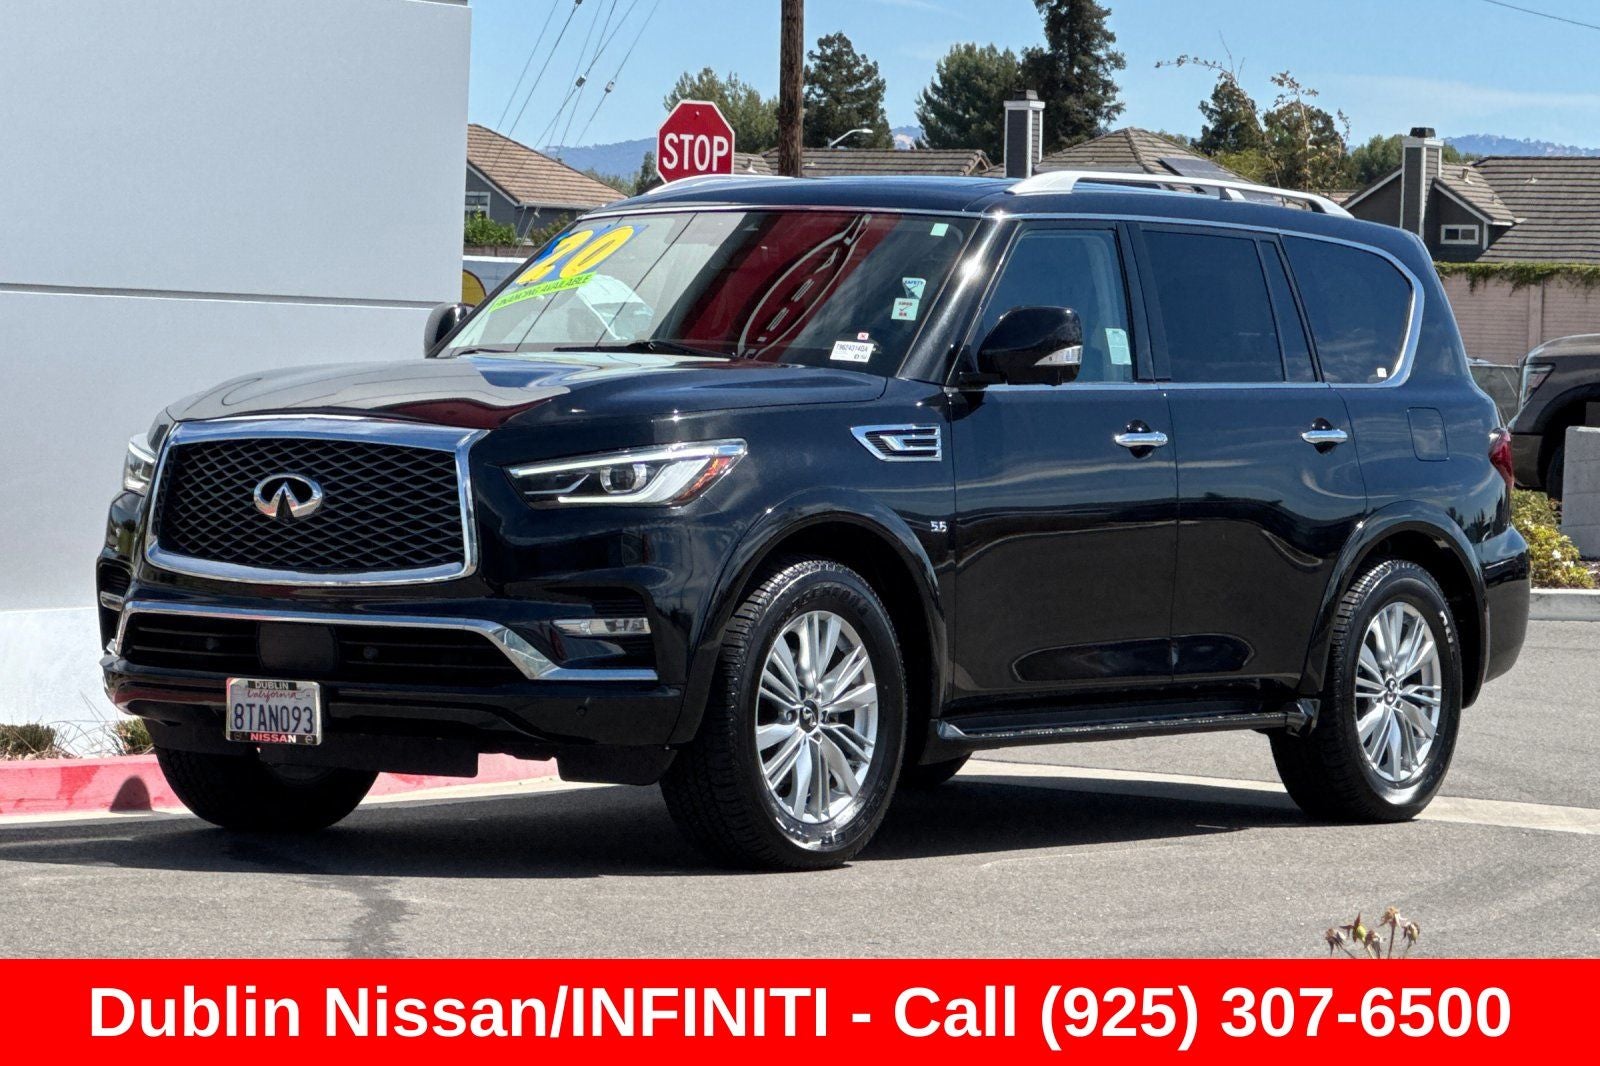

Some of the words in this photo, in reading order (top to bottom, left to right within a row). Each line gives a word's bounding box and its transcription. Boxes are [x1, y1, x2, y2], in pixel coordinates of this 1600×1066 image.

[662, 132, 729, 172] STOP
[515, 225, 635, 284] 20
[247, 690, 297, 703] California
[254, 681, 289, 690] DUBLIN
[234, 703, 314, 734] 8TAN093
[250, 732, 297, 744] NISSAN
